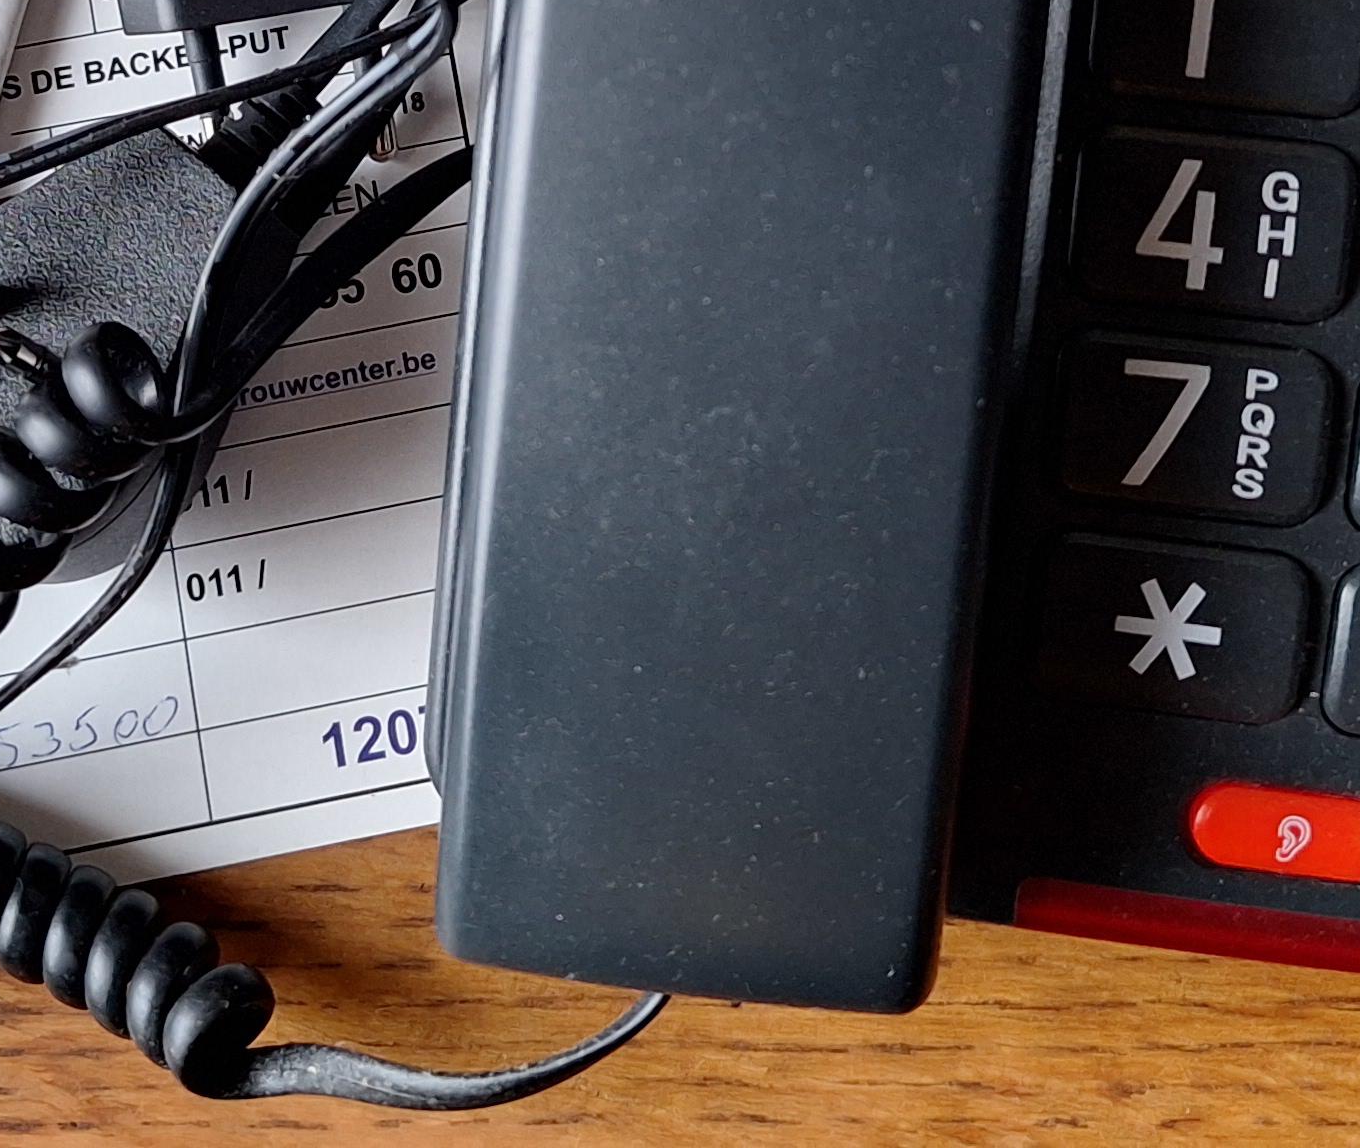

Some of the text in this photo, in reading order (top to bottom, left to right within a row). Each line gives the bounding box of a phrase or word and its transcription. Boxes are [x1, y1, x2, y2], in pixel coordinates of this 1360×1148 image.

[31, 65, 76, 95] DE
[83, 25, 290, 85] BACKE-PUT
[1135, 159, 1224, 290] 4
[1256, 171, 1300, 300] GHI
[391, 252, 442, 294] 60
[241, 352, 437, 406] rouwcenter.be
[1121, 358, 1211, 486] 7
[1232, 368, 1279, 500] PQRS
[186, 564, 243, 602] 011
